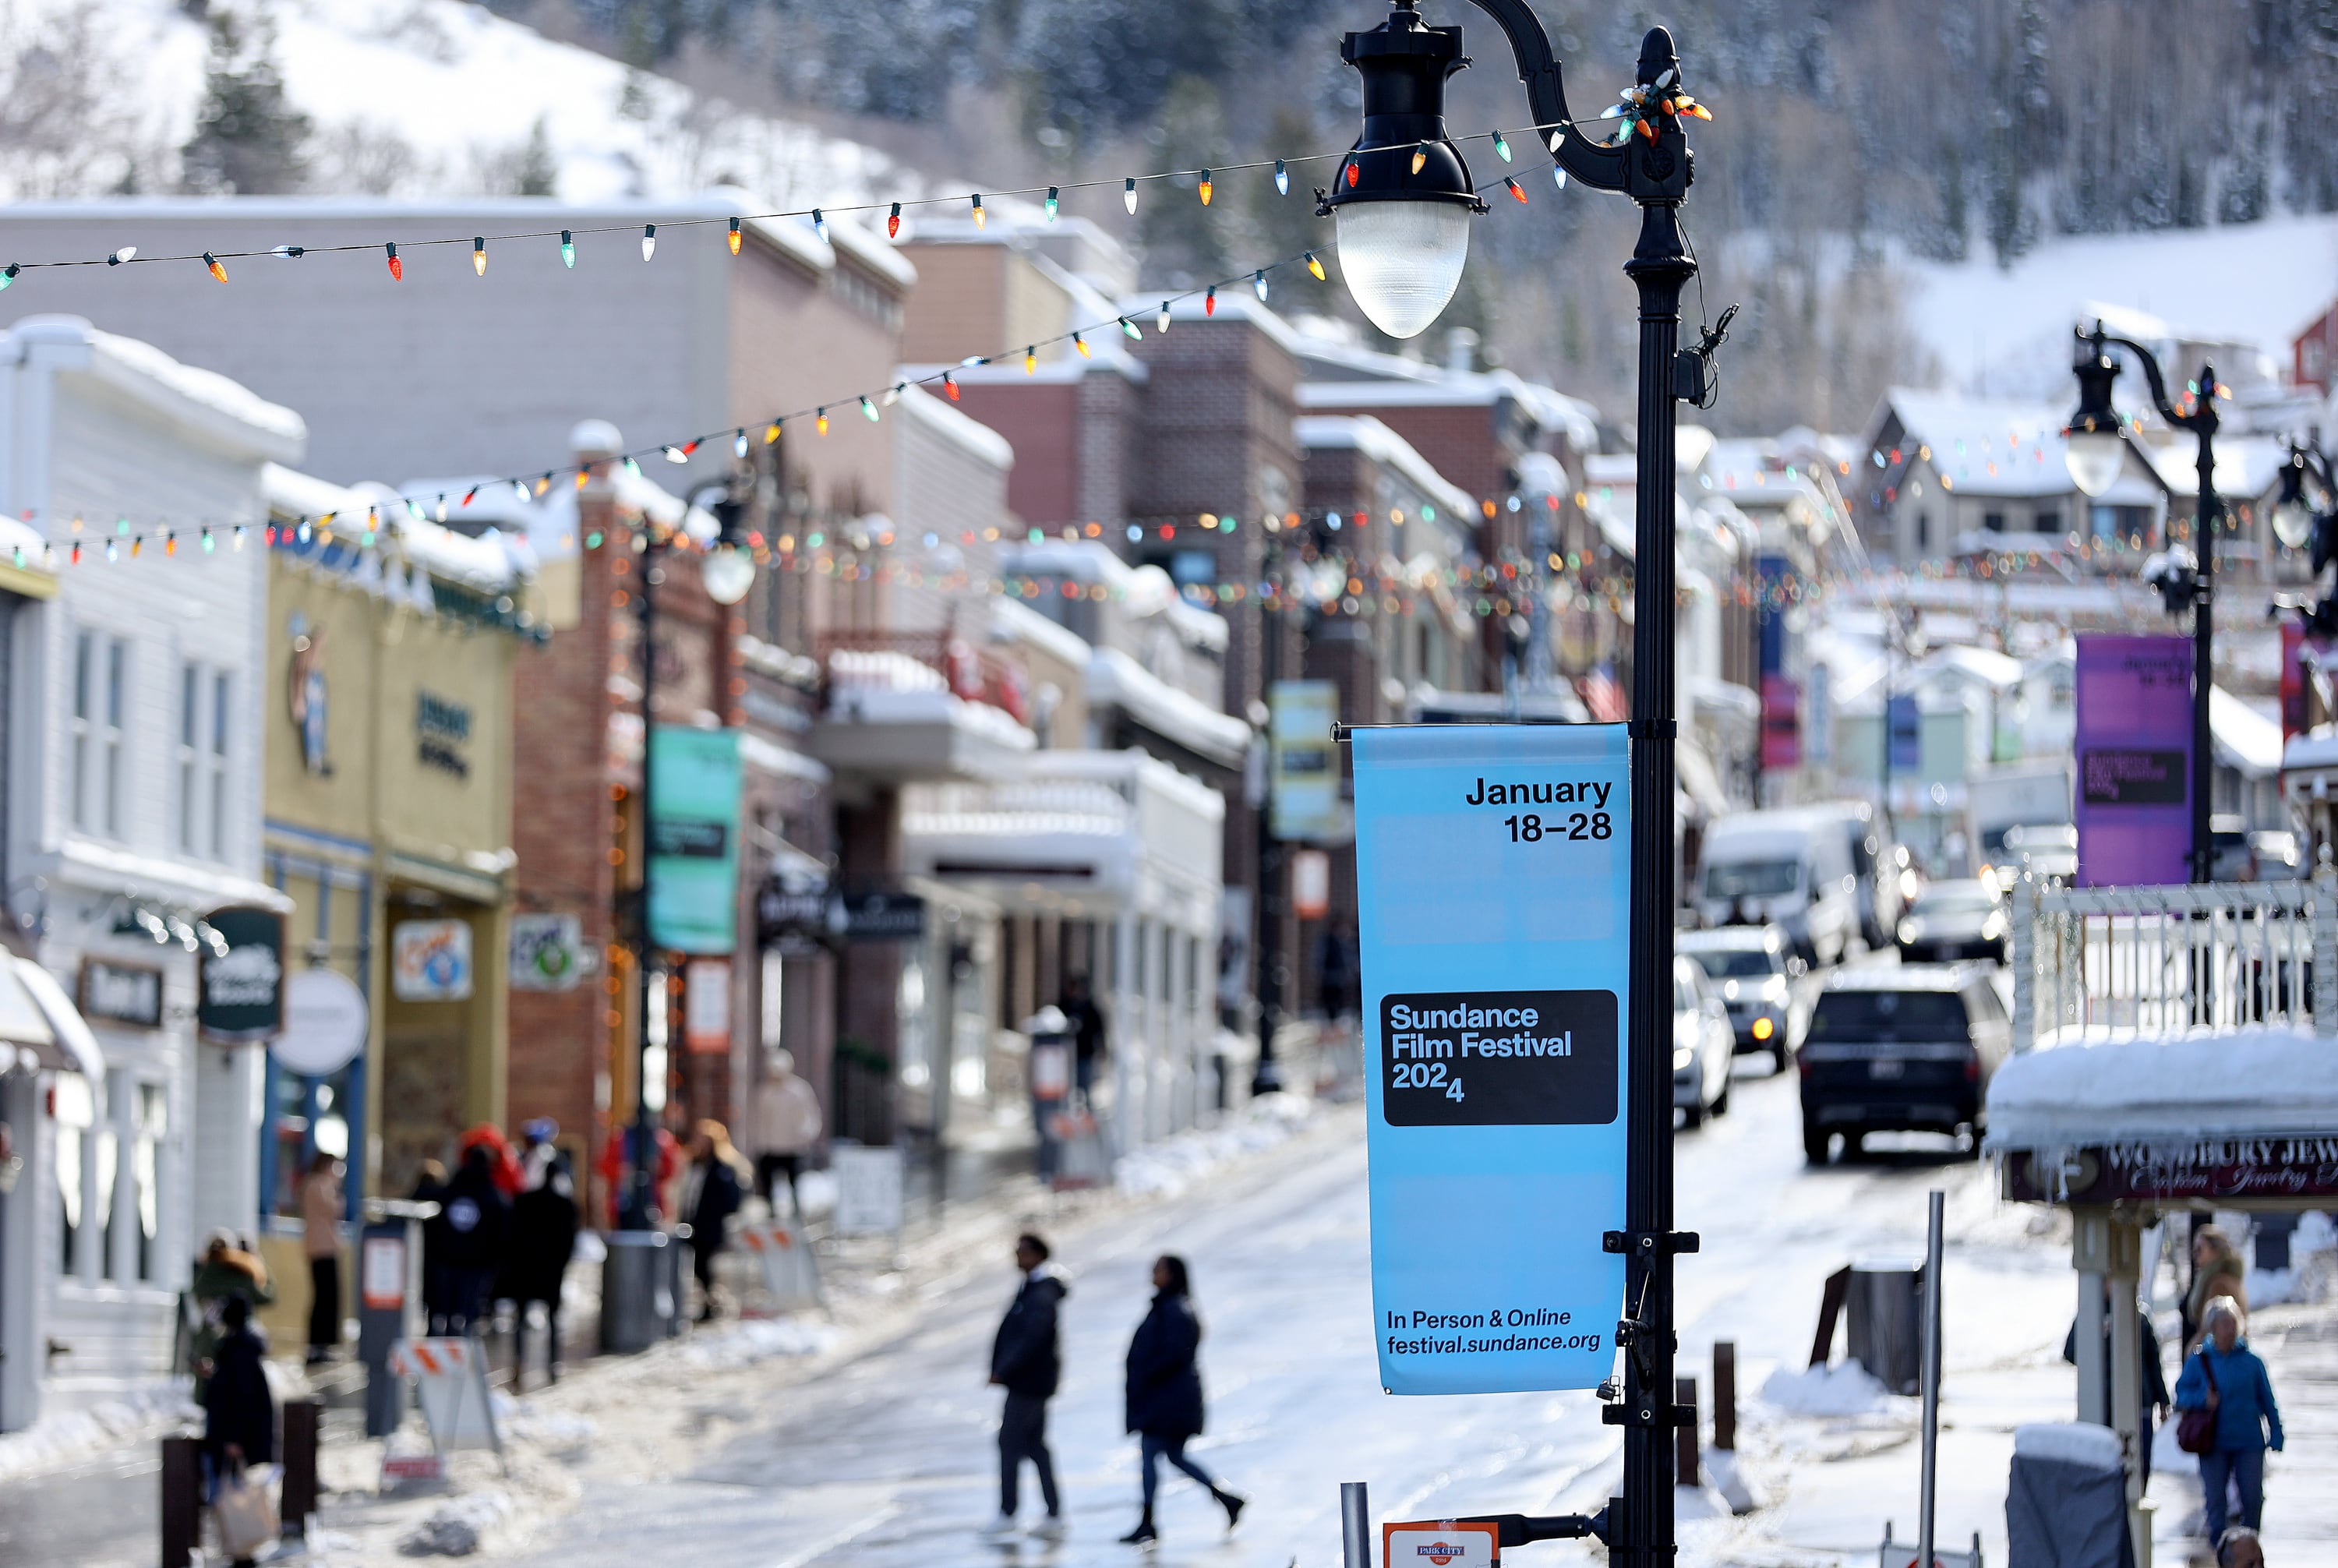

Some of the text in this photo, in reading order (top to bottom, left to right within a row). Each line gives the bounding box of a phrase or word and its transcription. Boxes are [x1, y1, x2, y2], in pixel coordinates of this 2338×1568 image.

[1465, 777, 1612, 809] January
[1390, 1002, 1539, 1029] Sundance
[1392, 1030, 1571, 1059] Film Festival
[1392, 1062, 1465, 1103] 2024
[1387, 1308, 1571, 1329] In Person & Online
[1387, 1333, 1601, 1355] festival.sundance.org
